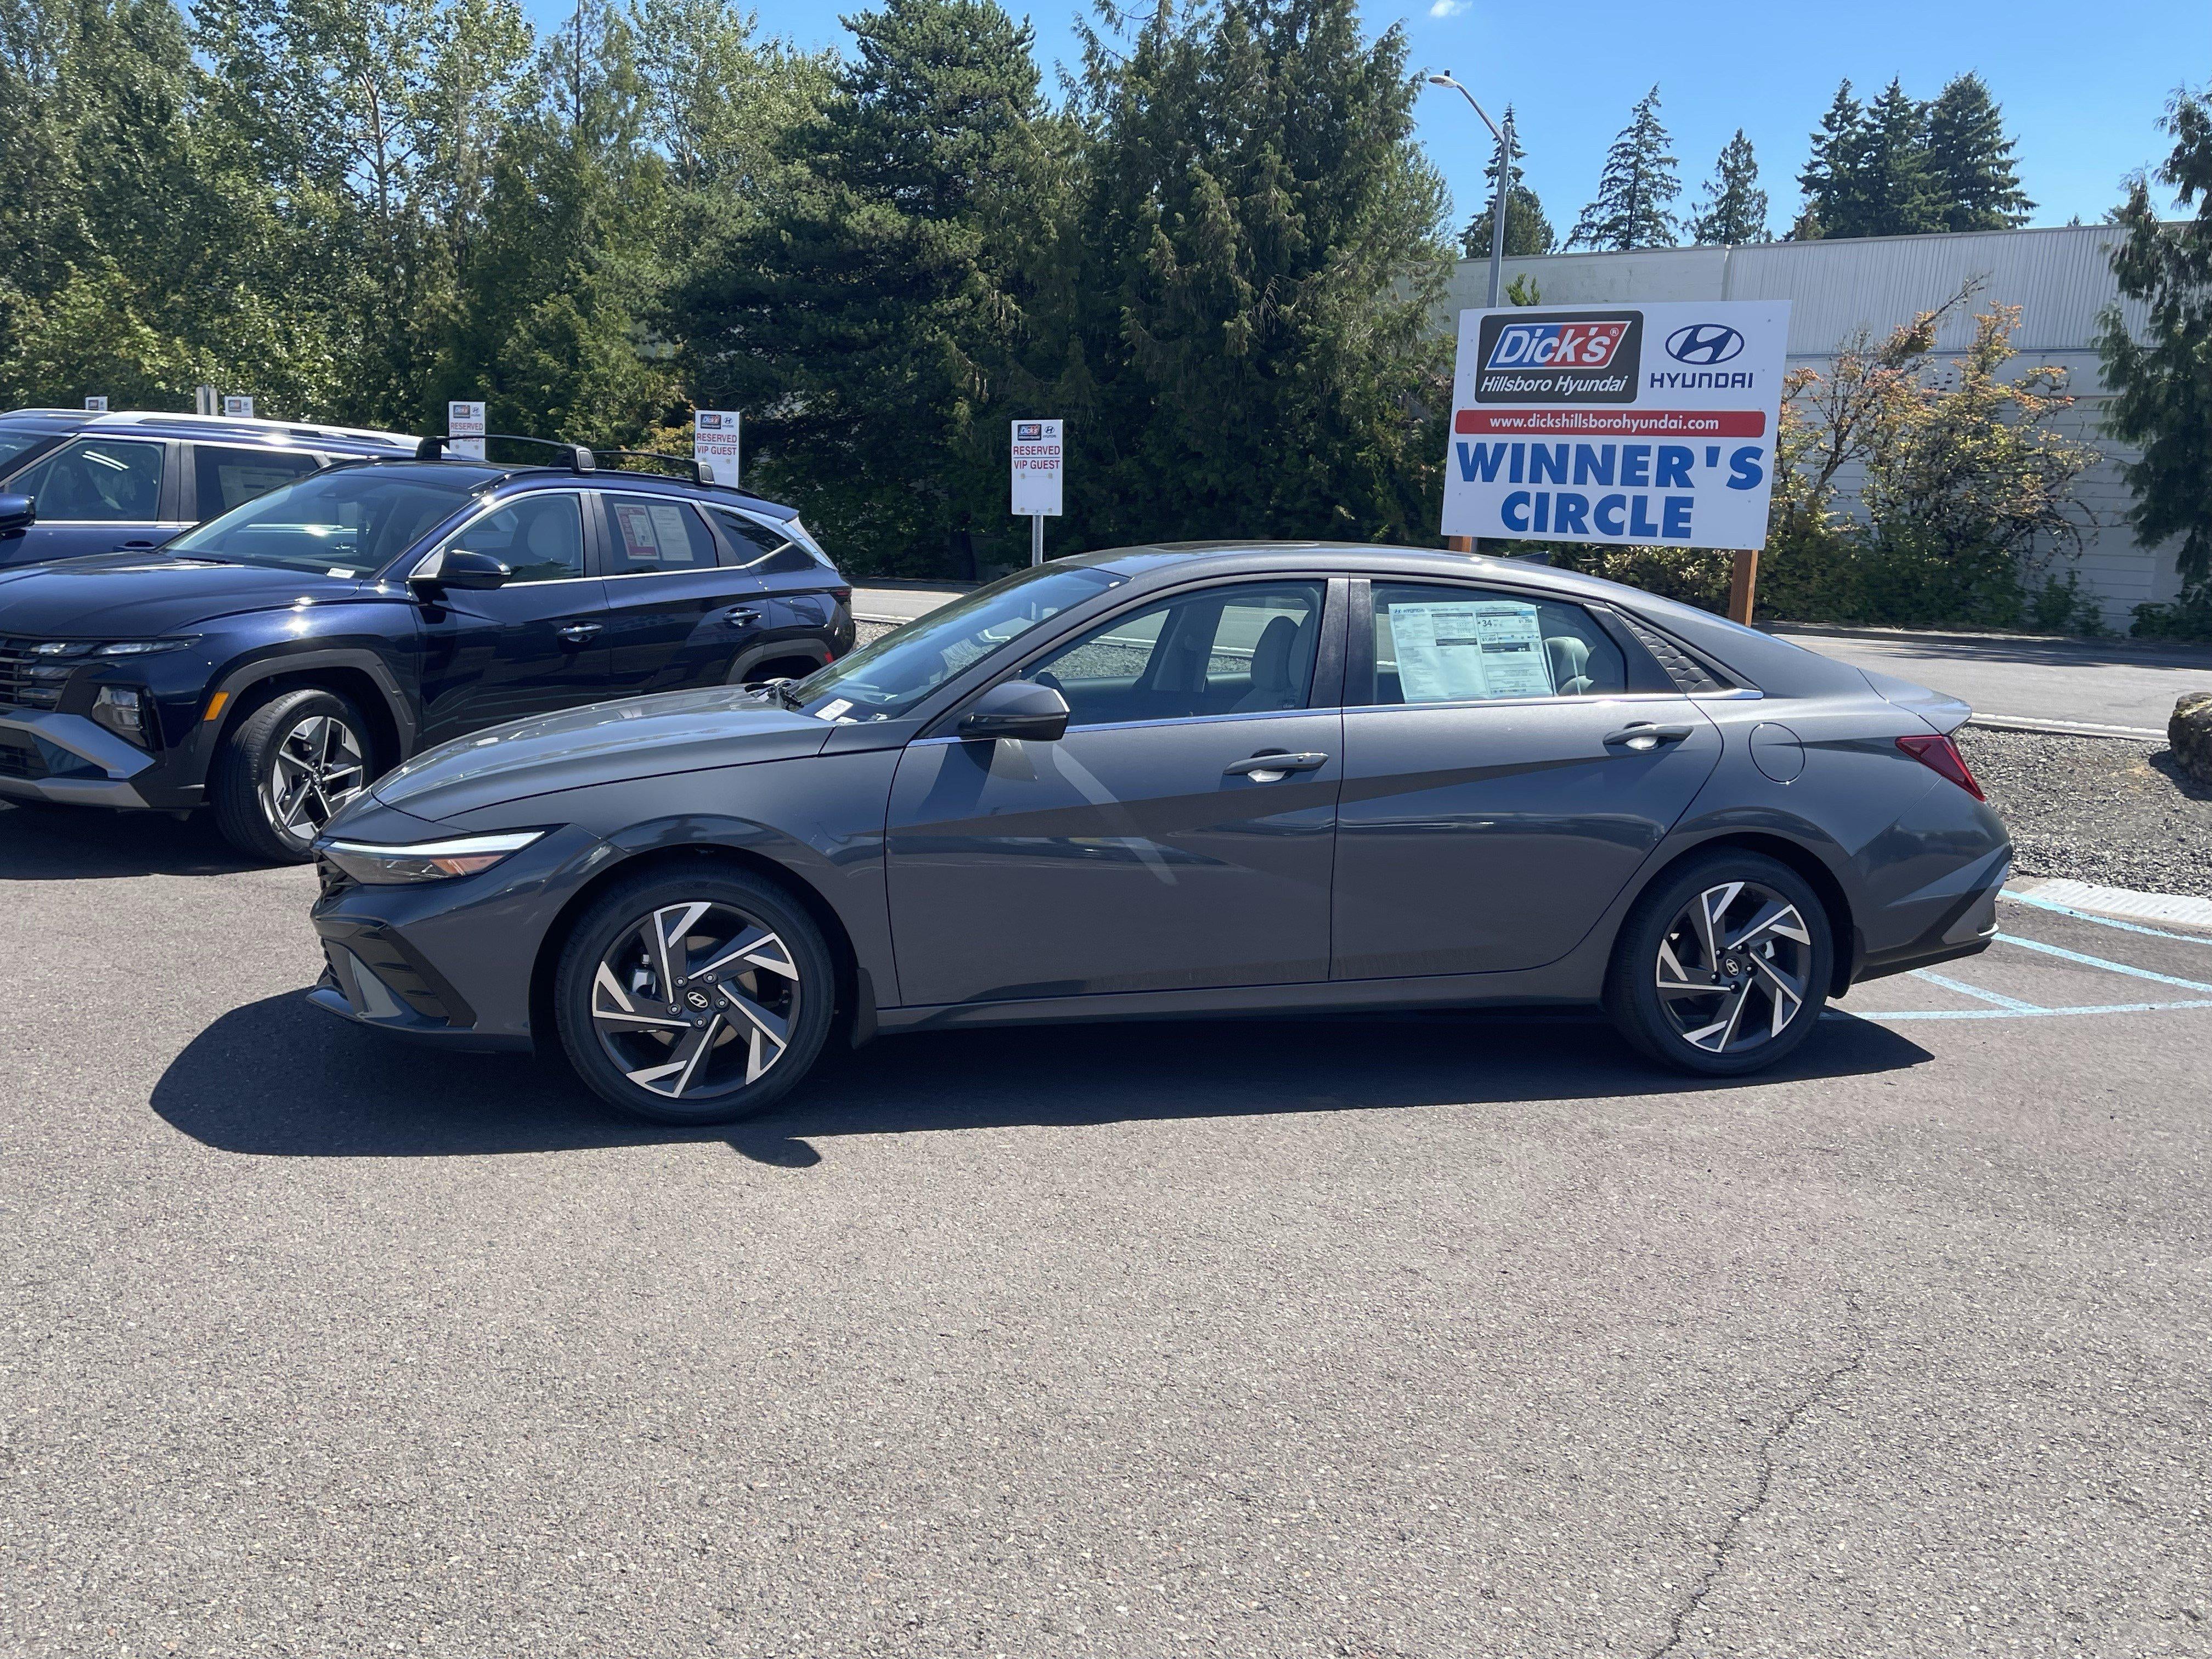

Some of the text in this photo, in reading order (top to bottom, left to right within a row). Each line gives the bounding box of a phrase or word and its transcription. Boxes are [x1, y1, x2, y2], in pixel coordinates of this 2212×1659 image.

[1496, 326, 1611, 364] Dick's
[1480, 374, 1629, 396] Hillsboro Hyundai
[1650, 373, 1753, 388] HYUNDAI
[450, 422, 483, 431] RESERVED
[1489, 413, 1719, 433] www.dickshillsborohyundai.com
[696, 433, 737, 443] RESERVED
[697, 445, 737, 455] VIP GUEST
[1013, 445, 1060, 455] RESERVED
[1014, 460, 1060, 470] VIP GUEST
[1456, 442, 1764, 490] WINNER'S
[1500, 490, 1694, 539] CIRCLE
